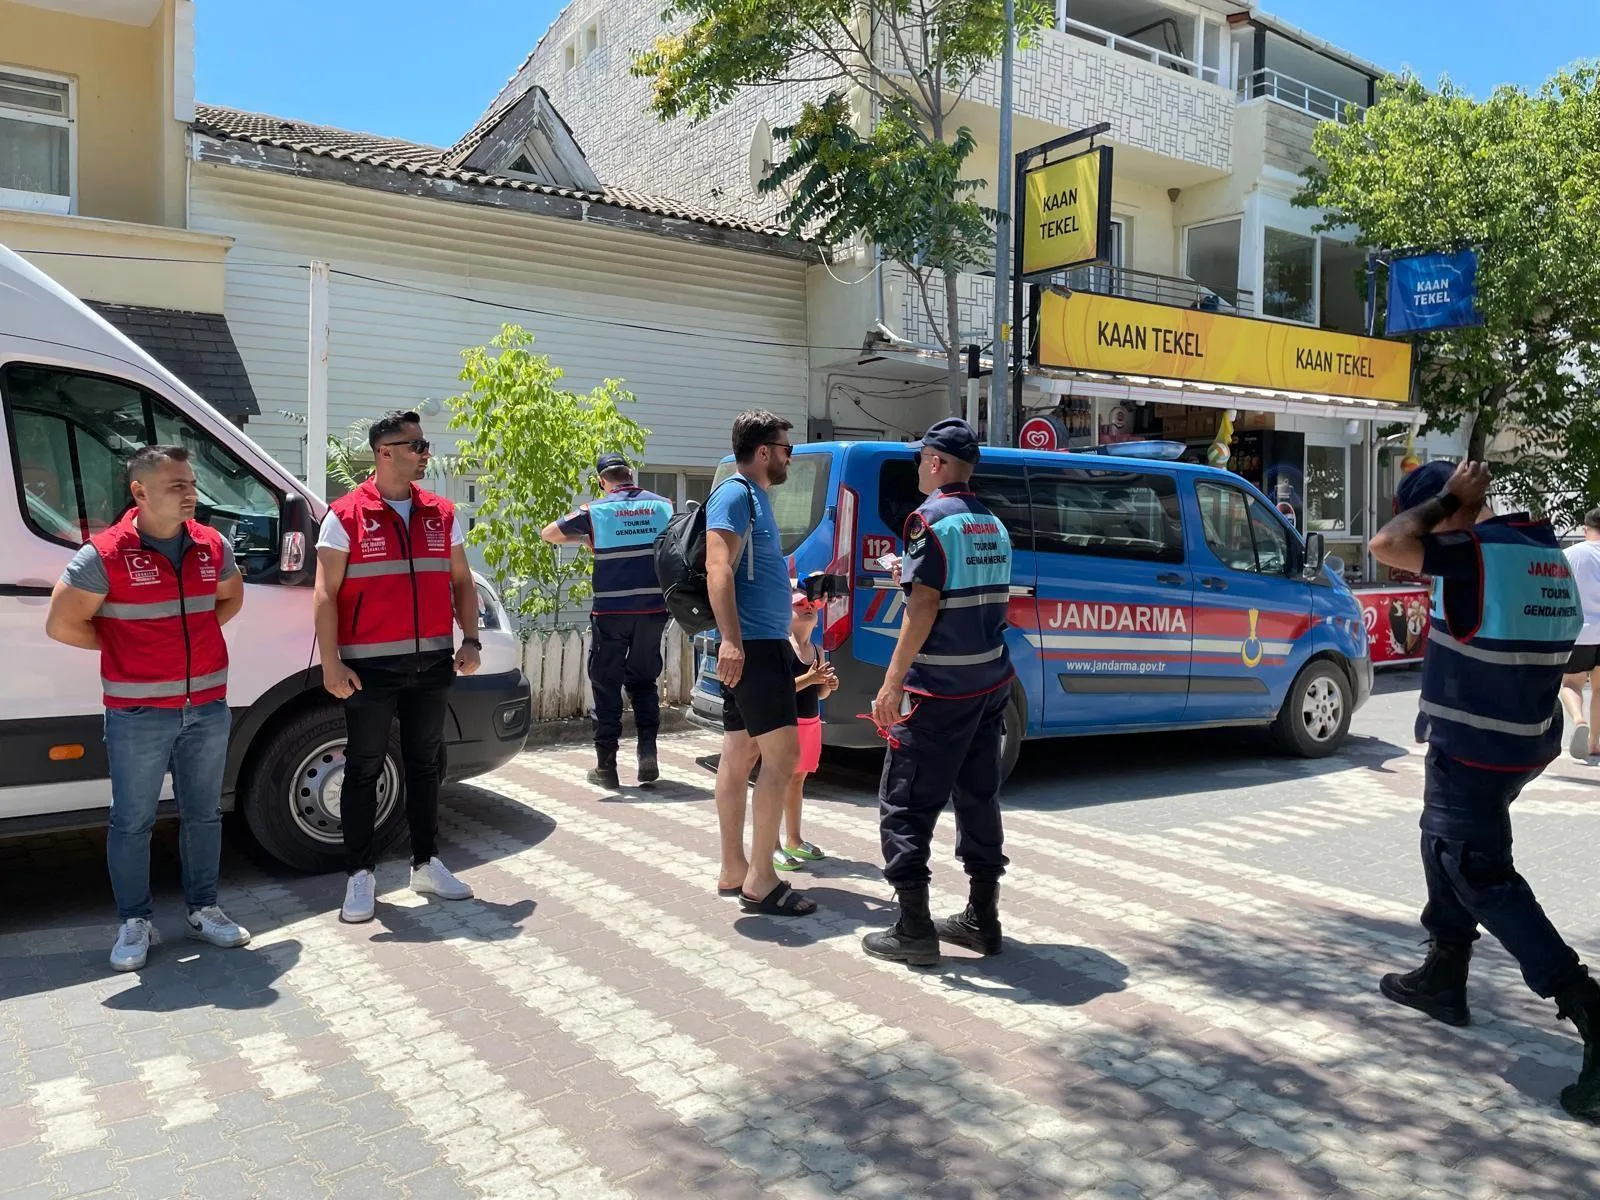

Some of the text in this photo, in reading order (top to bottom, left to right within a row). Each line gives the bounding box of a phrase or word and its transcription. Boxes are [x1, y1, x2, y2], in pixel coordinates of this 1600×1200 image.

[1043, 188, 1077, 213] KAAN
[1040, 216, 1079, 240] TEKEL
[1417, 279, 1449, 292] KAAN
[1413, 291, 1450, 306] TEKEL
[1098, 320, 1204, 357] KAAN TEKEL
[1296, 347, 1374, 378] KAAN TEKEL
[615, 508, 656, 518] JANDARMA
[962, 523, 999, 535] JANDARMA
[867, 538, 891, 557] 112
[1048, 602, 1187, 632] JANDARMA
[1066, 659, 1166, 674] www.jandarma.gov.tr
